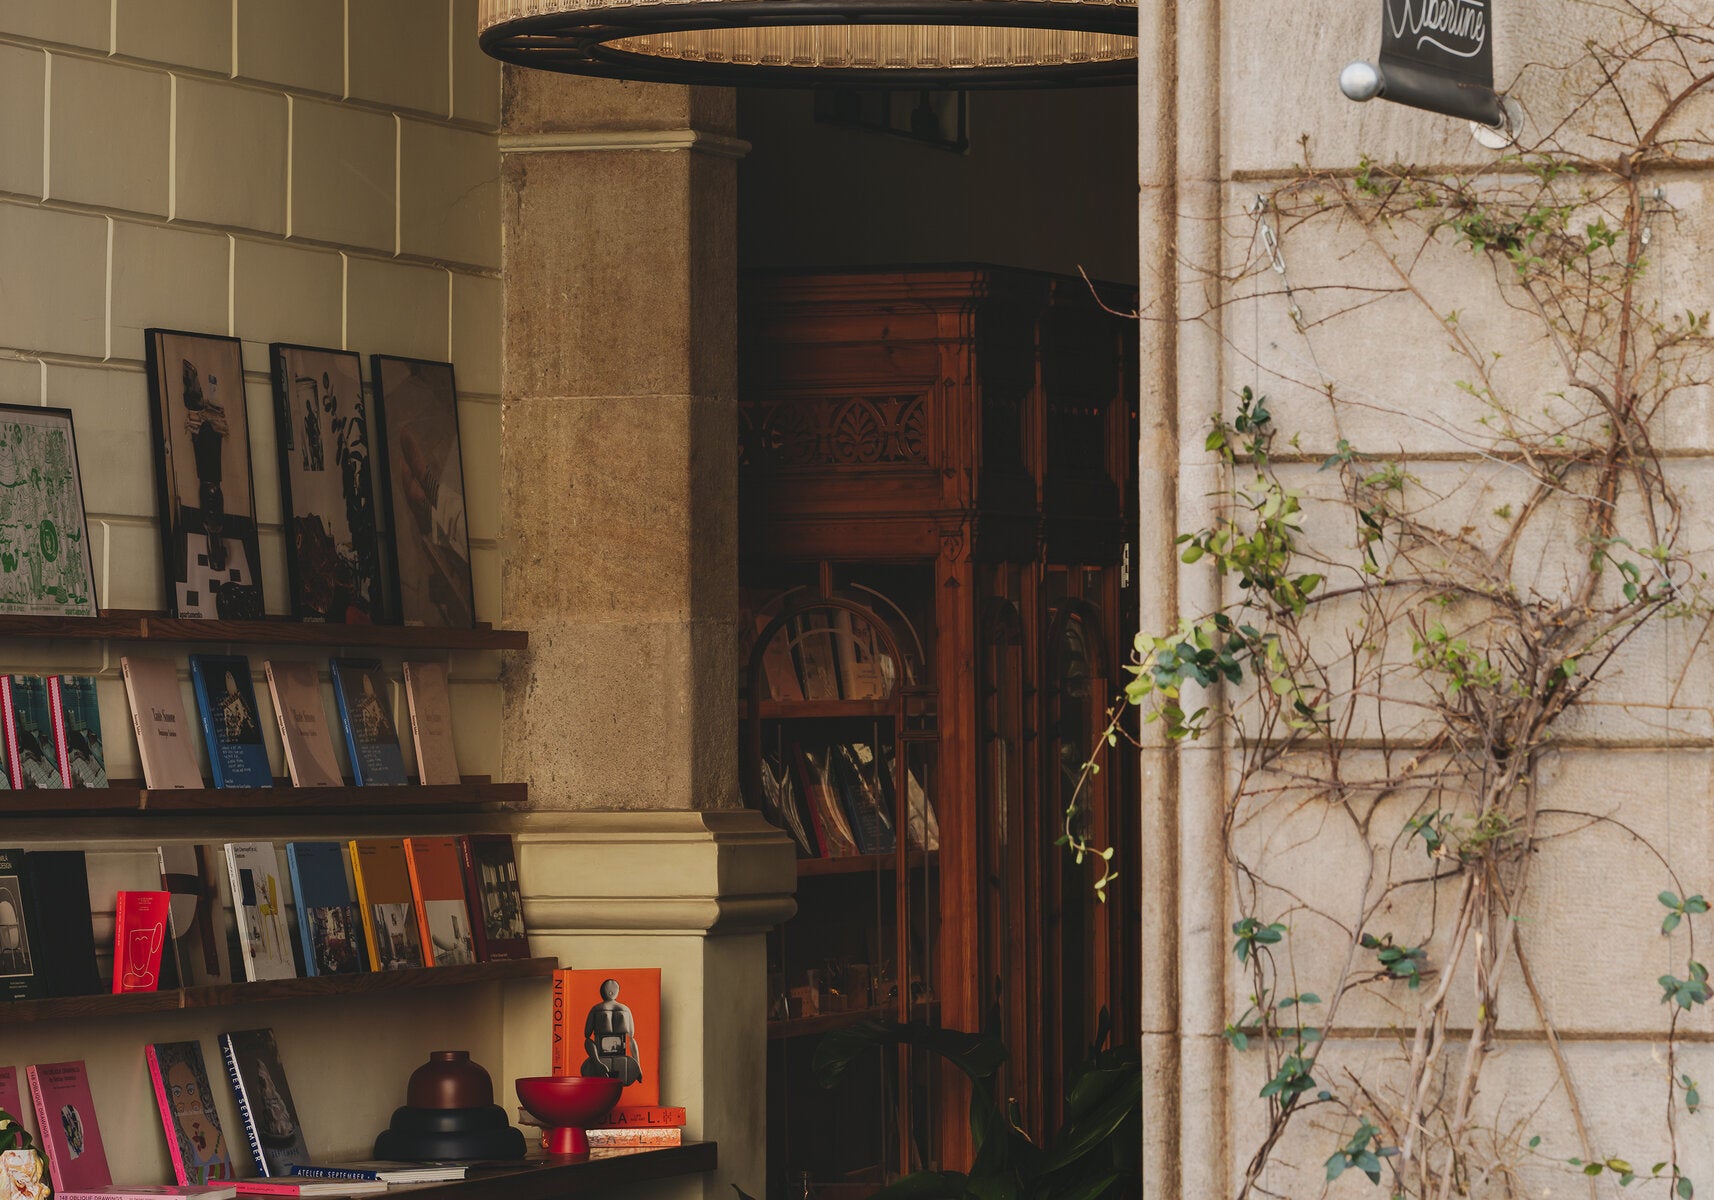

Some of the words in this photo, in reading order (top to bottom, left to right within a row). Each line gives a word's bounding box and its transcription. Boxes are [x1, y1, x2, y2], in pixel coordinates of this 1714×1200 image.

[554, 979, 562, 1043] NICOLA
[224, 1046, 241, 1091] ATELIER
[238, 1098, 261, 1162] SEPTEMBER
[648, 1112, 660, 1123] L.
[297, 1169, 324, 1178] ATELIER
[327, 1170, 365, 1179] SEPTEMBER
